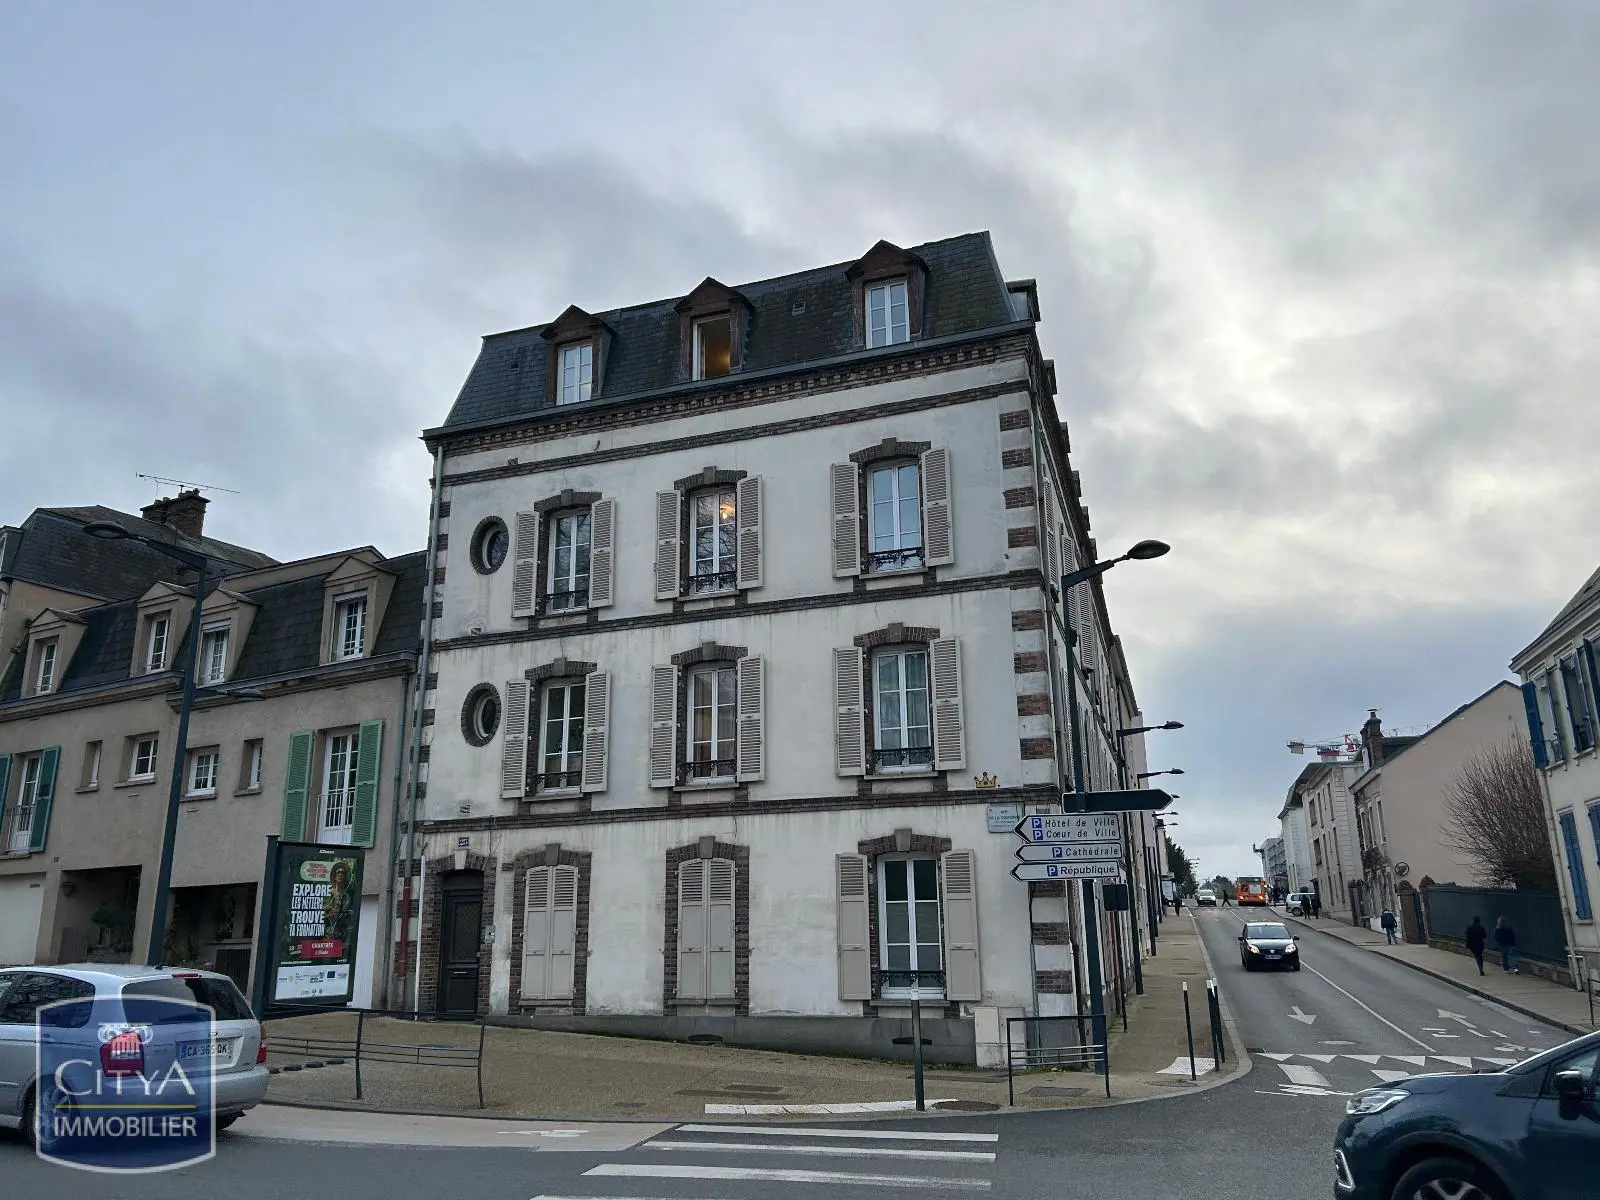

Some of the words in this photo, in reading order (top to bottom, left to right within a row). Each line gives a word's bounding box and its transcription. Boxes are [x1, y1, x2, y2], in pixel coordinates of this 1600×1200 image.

[1045, 817, 1070, 828] Hôtel
[1076, 818, 1087, 827] de
[1094, 817, 1115, 826] Ville
[1078, 828, 1088, 837] de
[1095, 828, 1116, 837] Ville
[1065, 847, 1119, 857] Cathédrale
[1060, 865, 1115, 876] République
[293, 883, 333, 897] EXPLORE
[291, 896, 301, 910] LES
[290, 910, 325, 924] TROUVE
[296, 923, 325, 937] FORMATION
